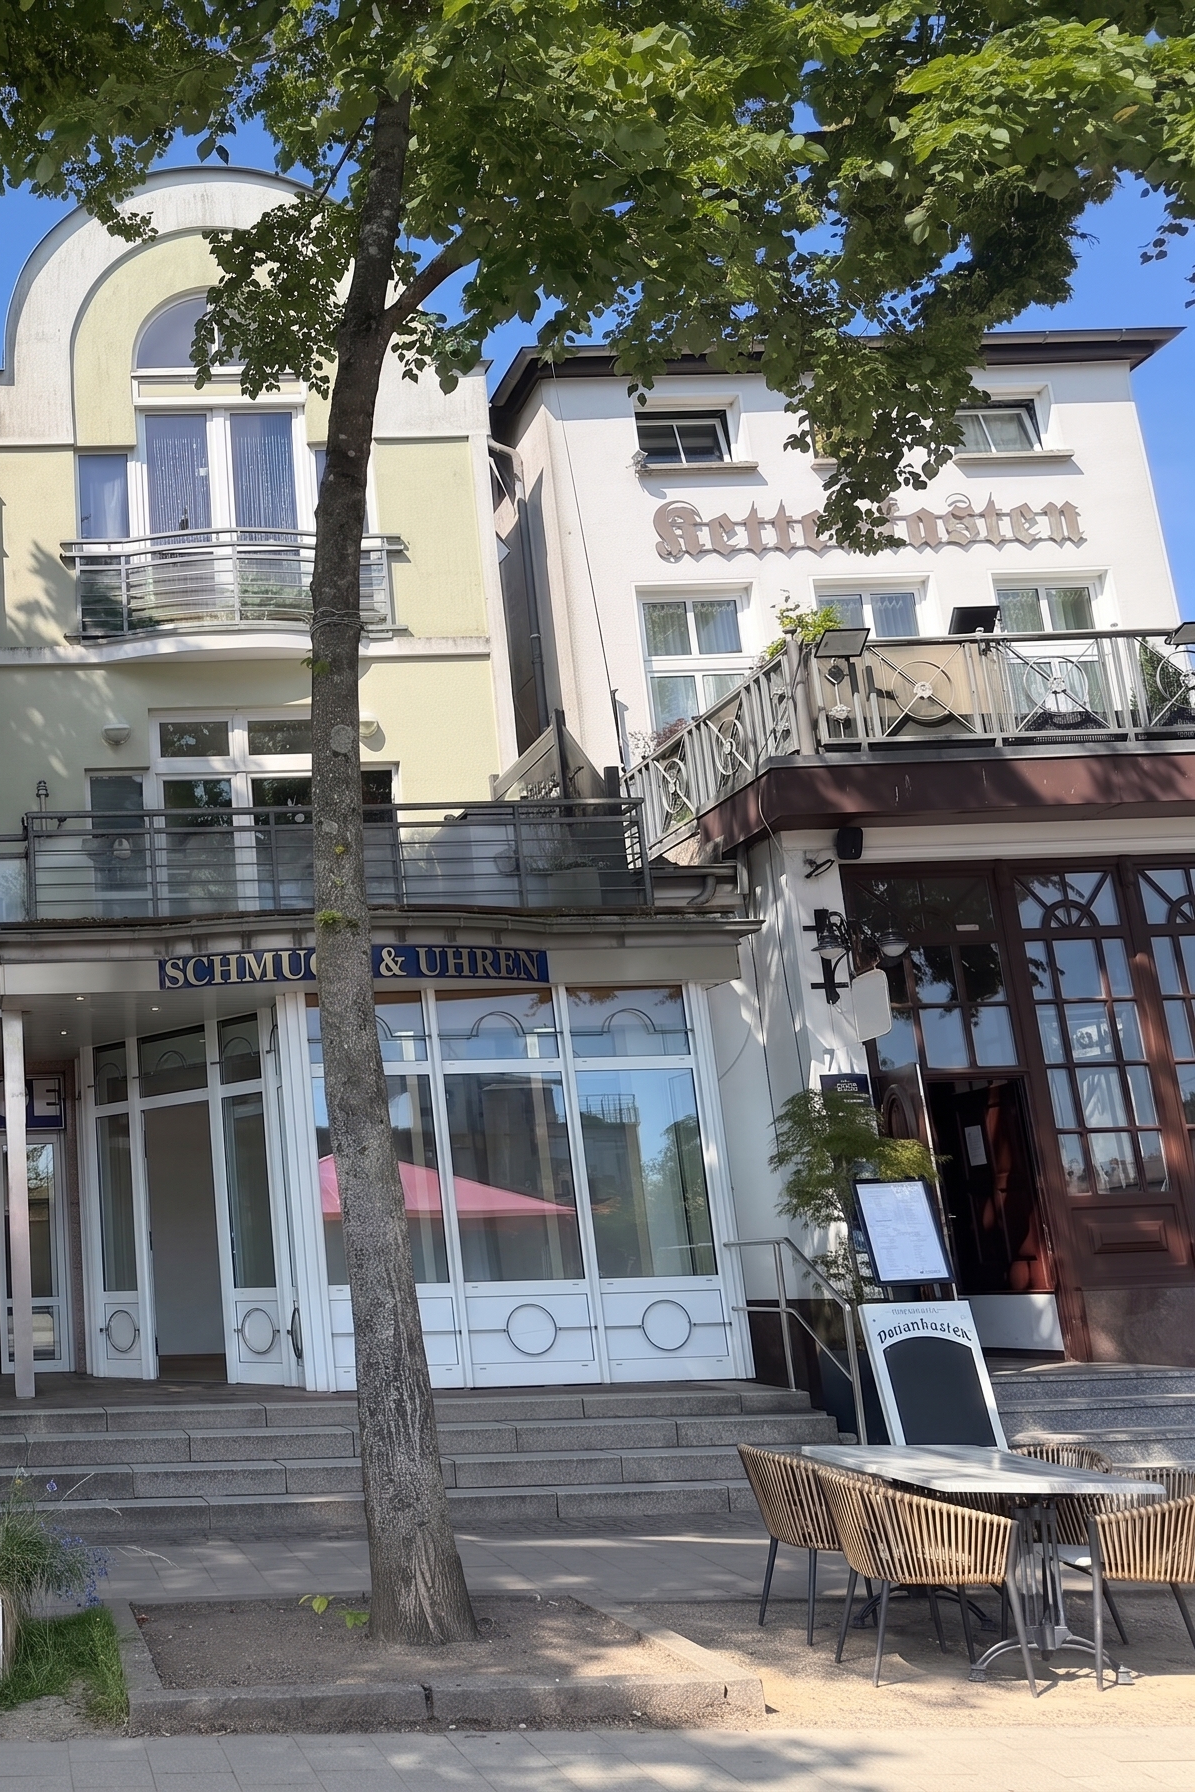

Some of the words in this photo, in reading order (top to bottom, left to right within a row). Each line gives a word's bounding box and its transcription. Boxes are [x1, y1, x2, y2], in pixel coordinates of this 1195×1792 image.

[653, 491, 1087, 558] Ketteasten
[165, 950, 316, 988] SCHMU
[379, 947, 407, 977] &
[415, 947, 539, 980] UHREN
